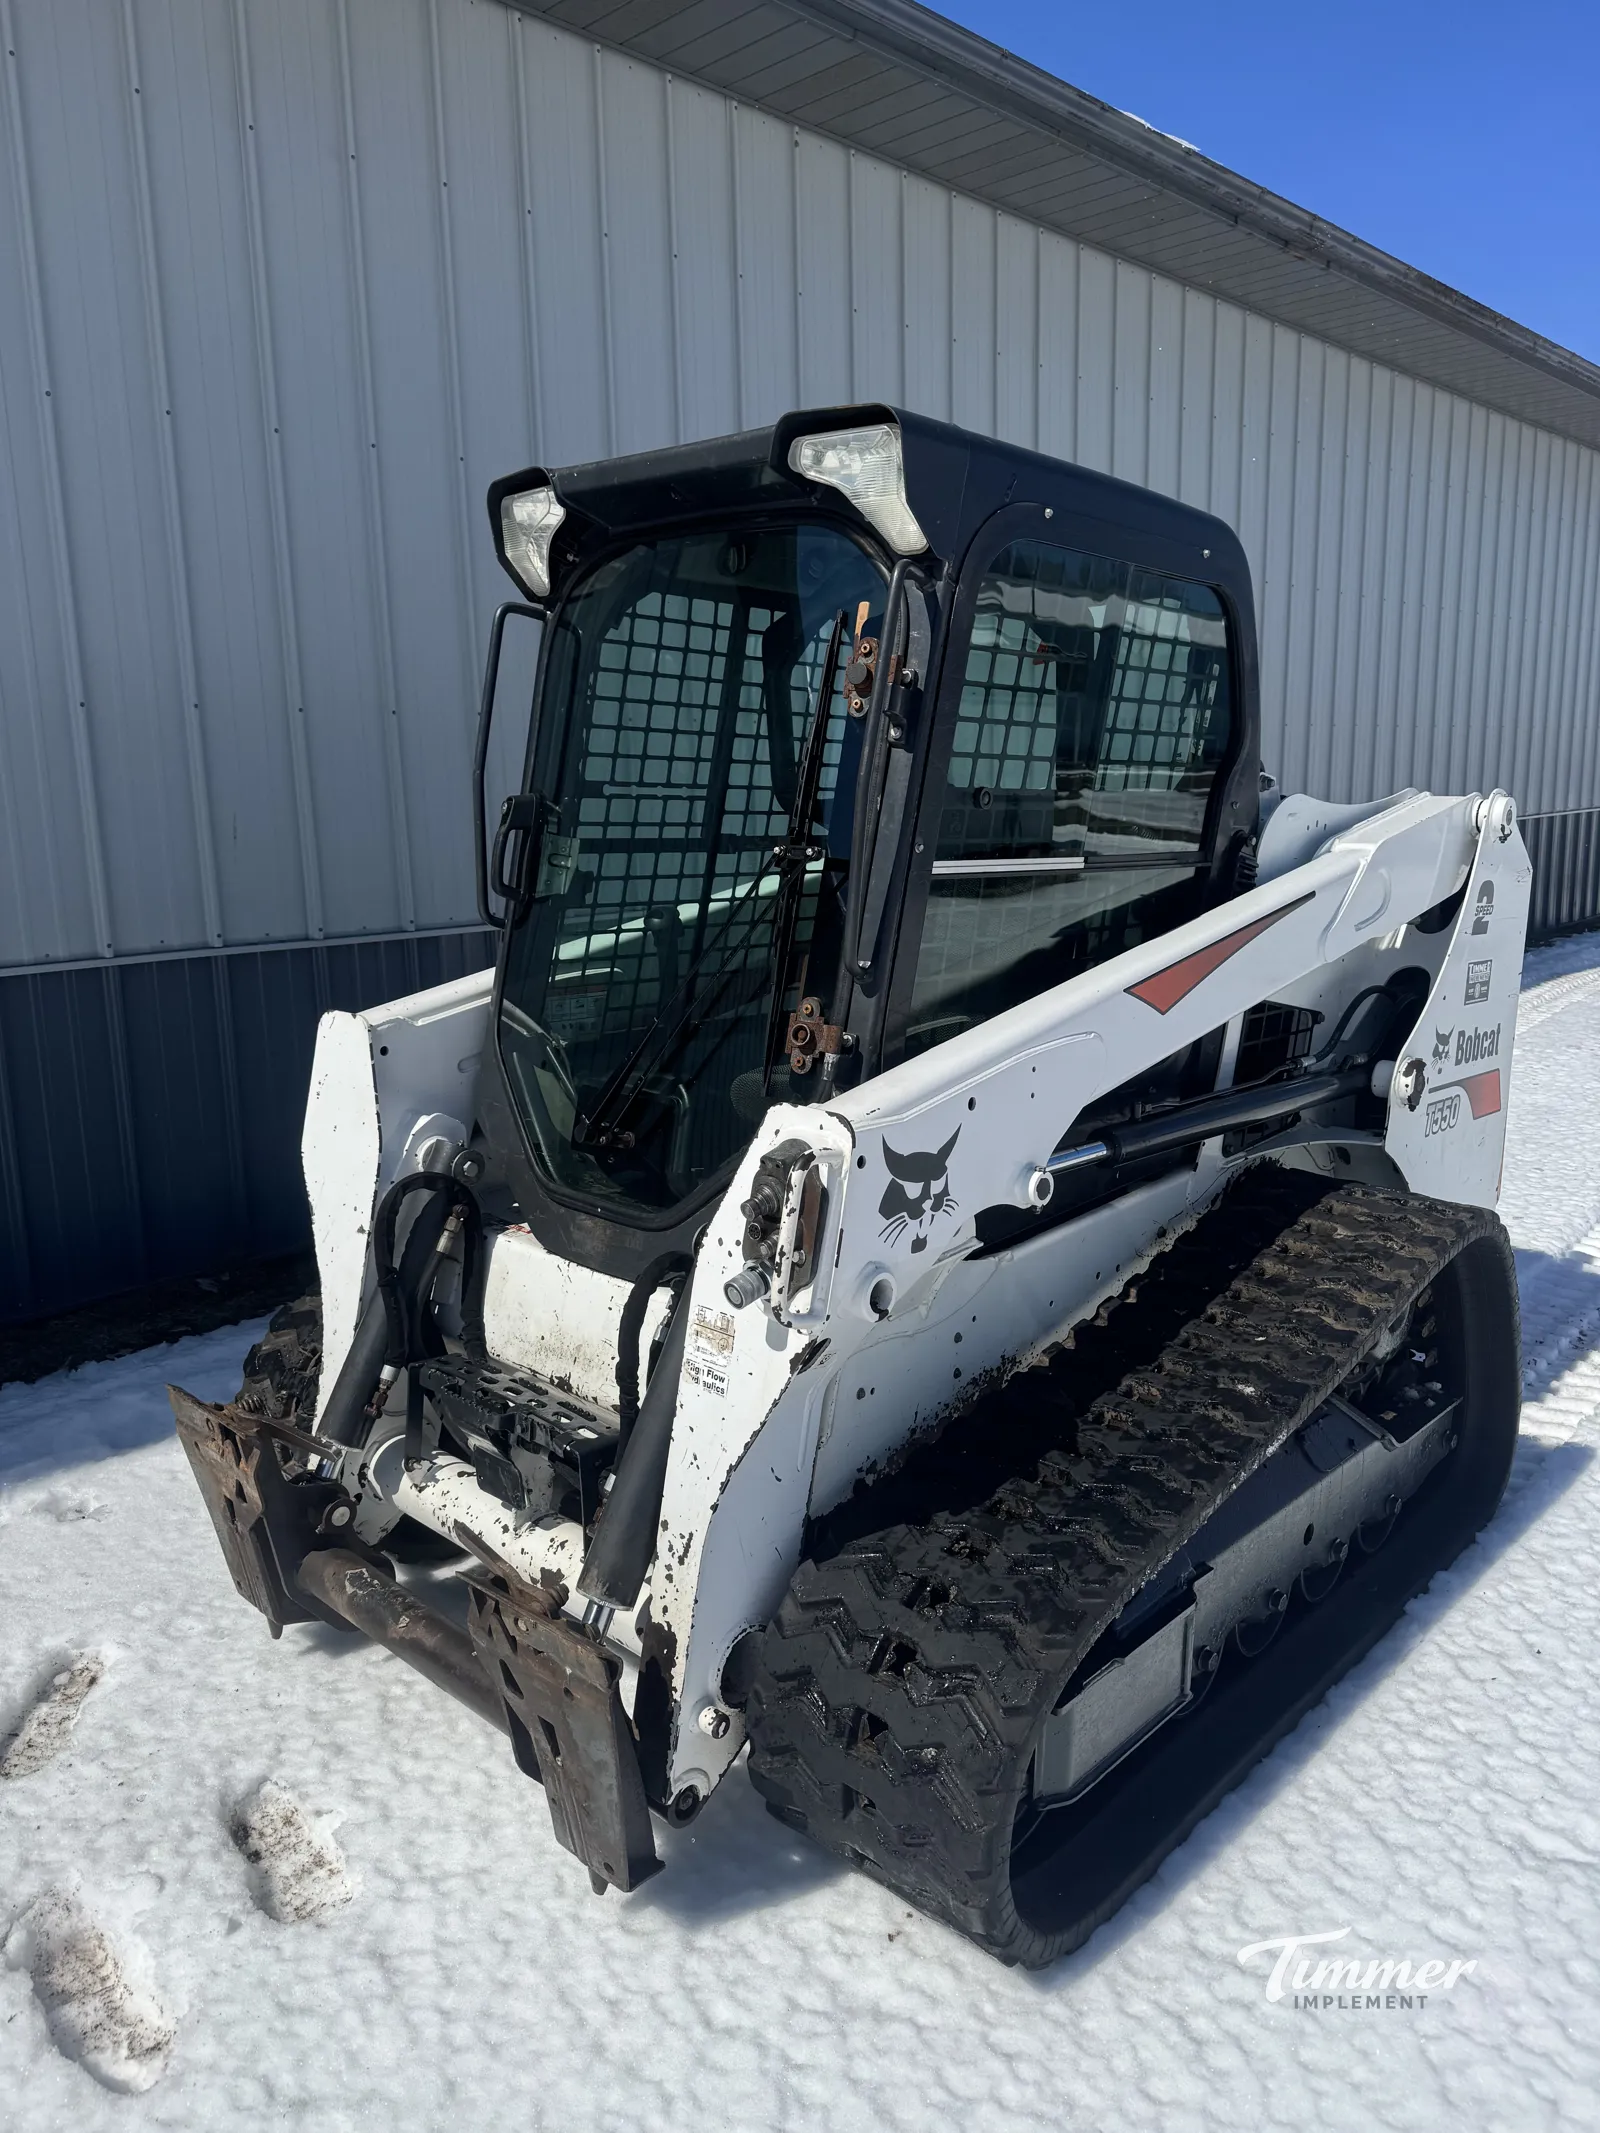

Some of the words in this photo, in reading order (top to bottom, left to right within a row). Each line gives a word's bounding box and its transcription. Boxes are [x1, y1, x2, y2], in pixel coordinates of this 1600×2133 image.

[1471, 879, 1495, 936] 2
[1475, 904, 1494, 917] SPEED
[1455, 1022, 1502, 1066] Bobcat
[1425, 1094, 1461, 1138] T550
[706, 1369, 726, 1383] Flow
